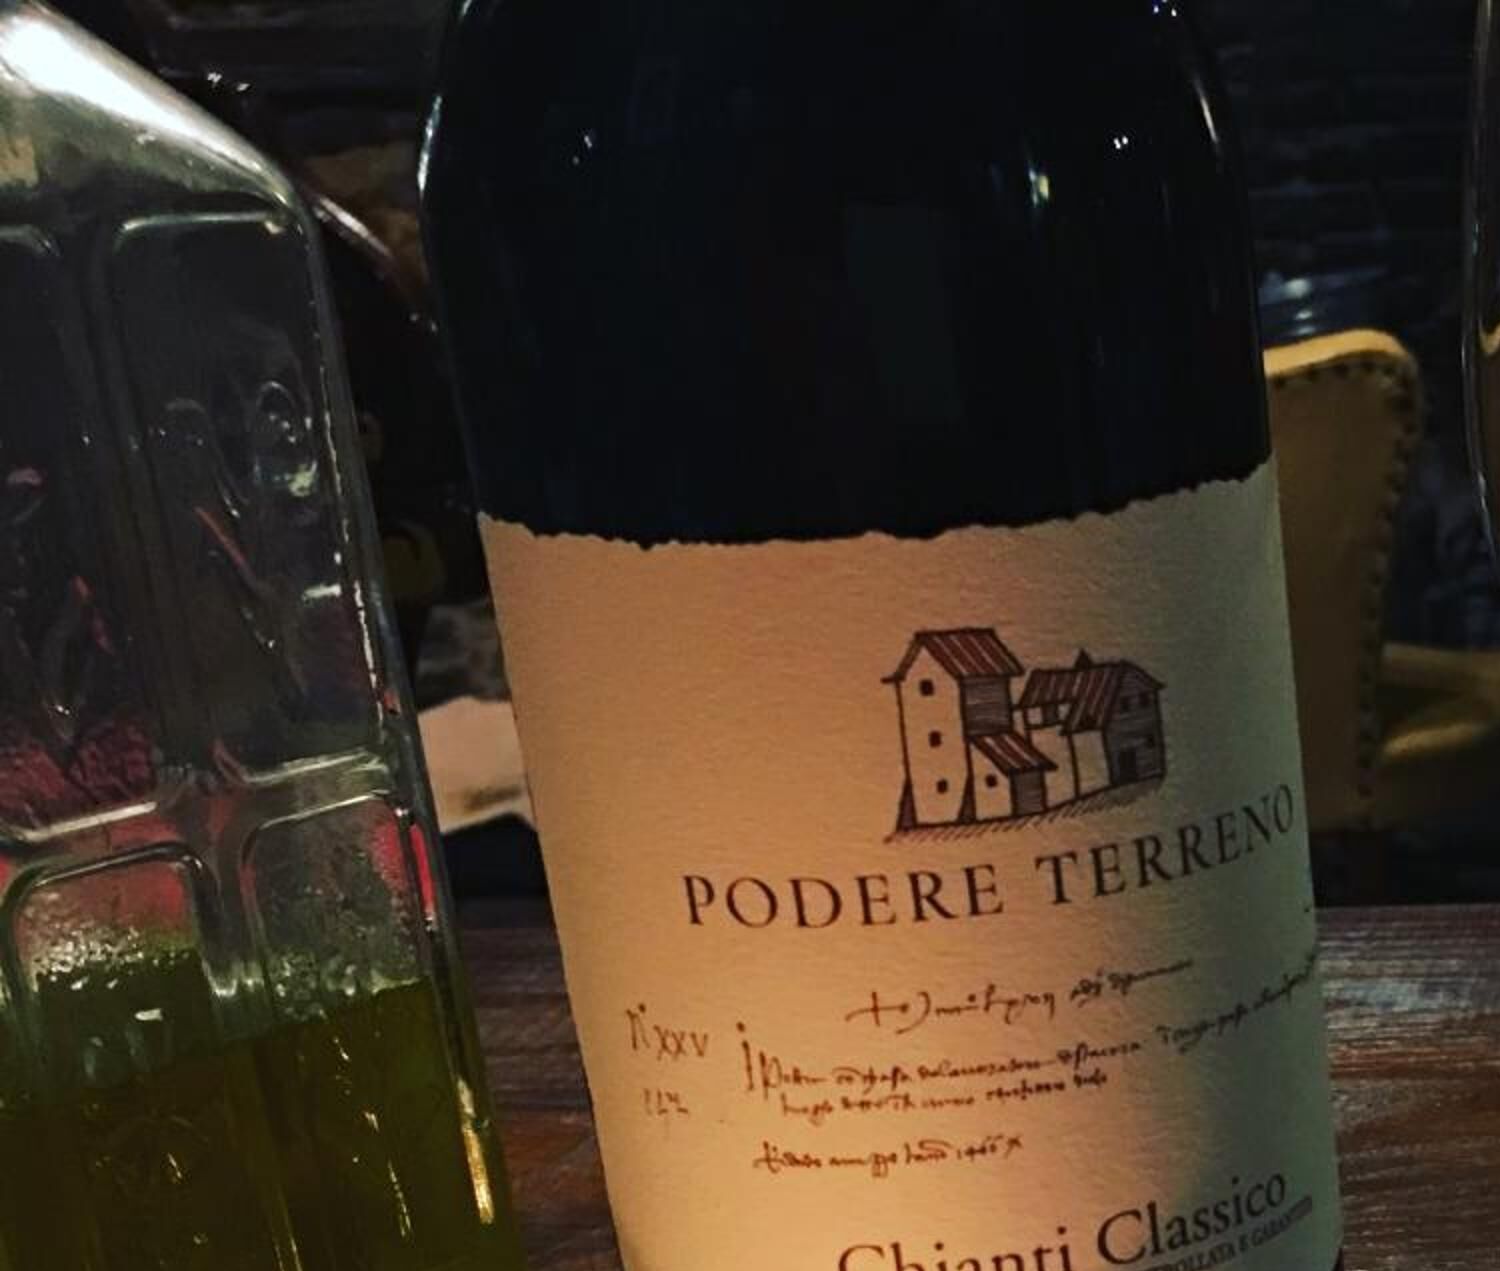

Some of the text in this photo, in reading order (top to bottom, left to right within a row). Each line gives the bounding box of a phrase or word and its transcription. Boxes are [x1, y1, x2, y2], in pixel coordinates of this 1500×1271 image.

[682, 783, 1295, 929] PODERE TERRENO
[1096, 1173, 1287, 1266] Classico
